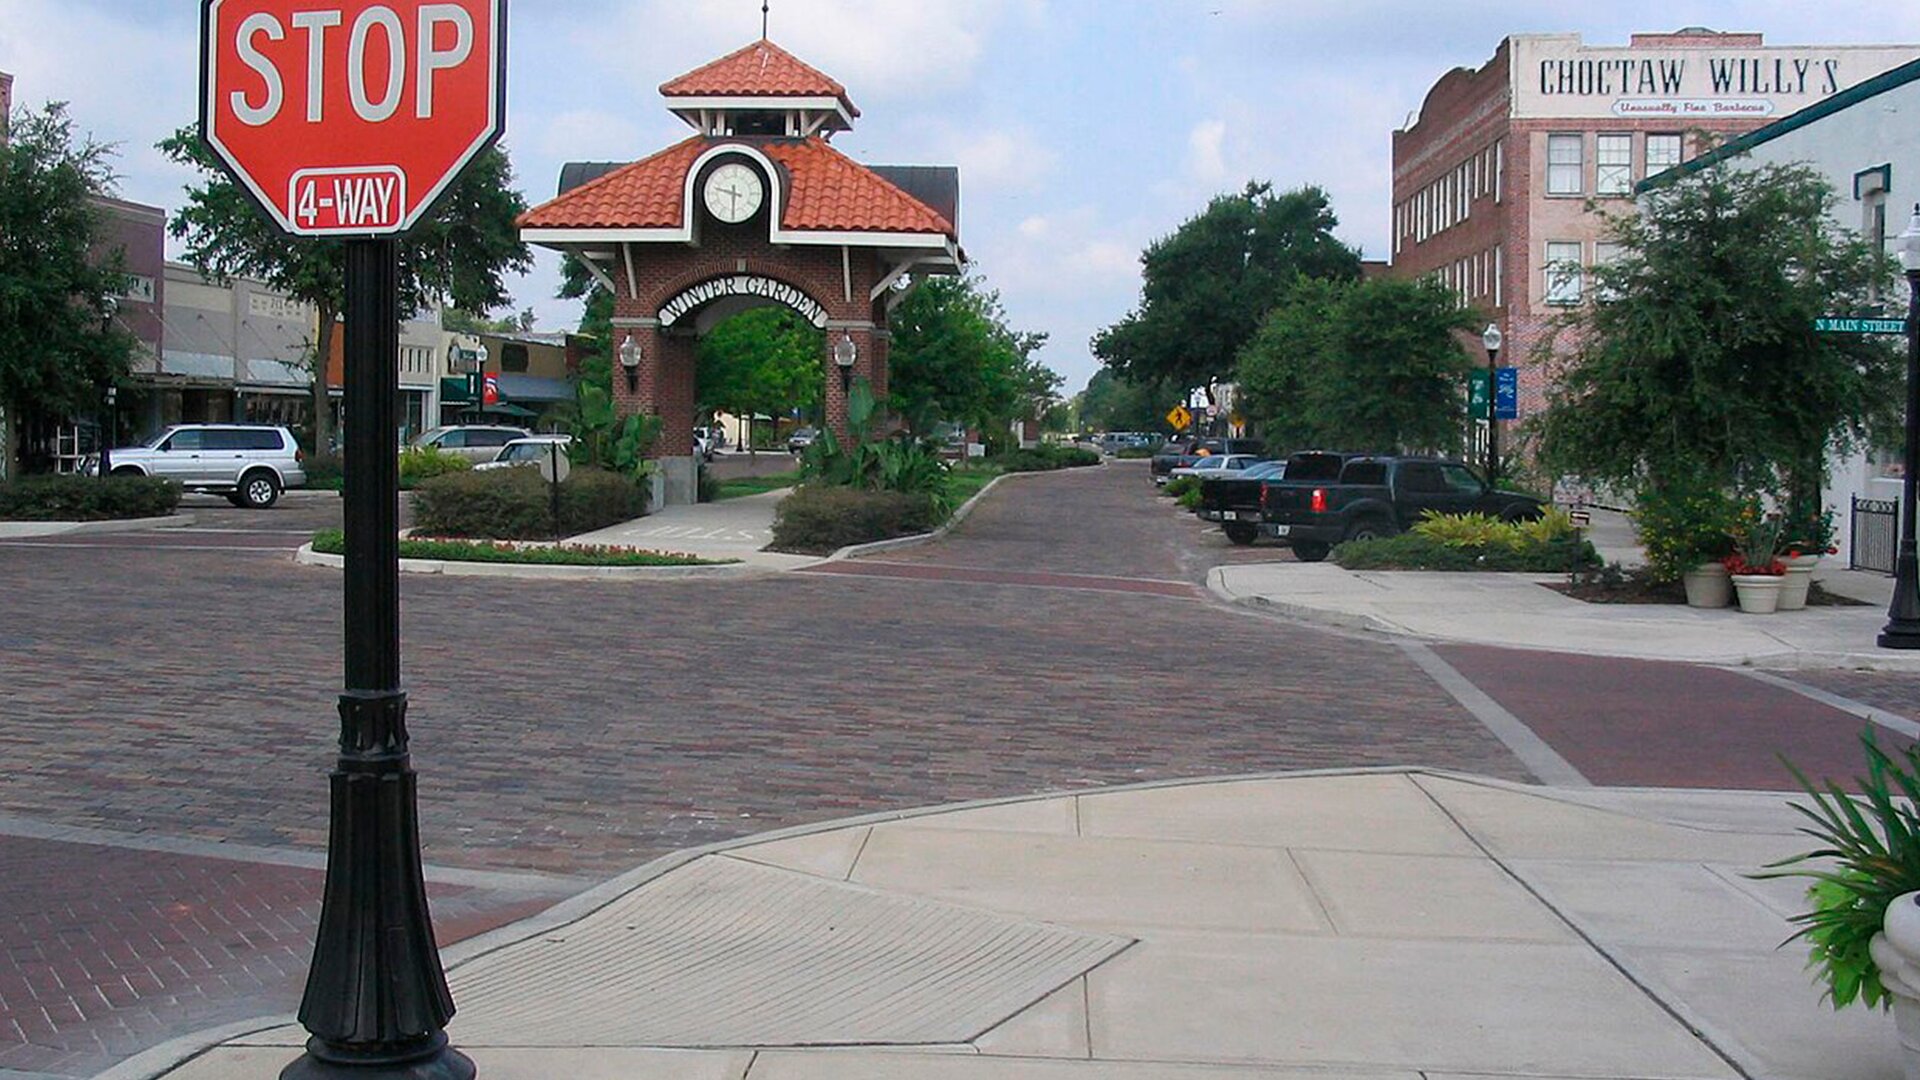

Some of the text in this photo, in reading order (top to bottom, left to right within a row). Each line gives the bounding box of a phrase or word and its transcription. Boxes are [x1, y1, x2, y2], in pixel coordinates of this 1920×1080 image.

[230, 3, 474, 126] STOP
[1540, 57, 1839, 96] CHOCTAW WILLY'S
[1620, 102, 1765, 114] Unusually Fine Barbecue
[298, 176, 395, 226] 4-WAY
[666, 277, 824, 322] WINTER GARDEN
[1815, 319, 1905, 333] N MAIN STREET
